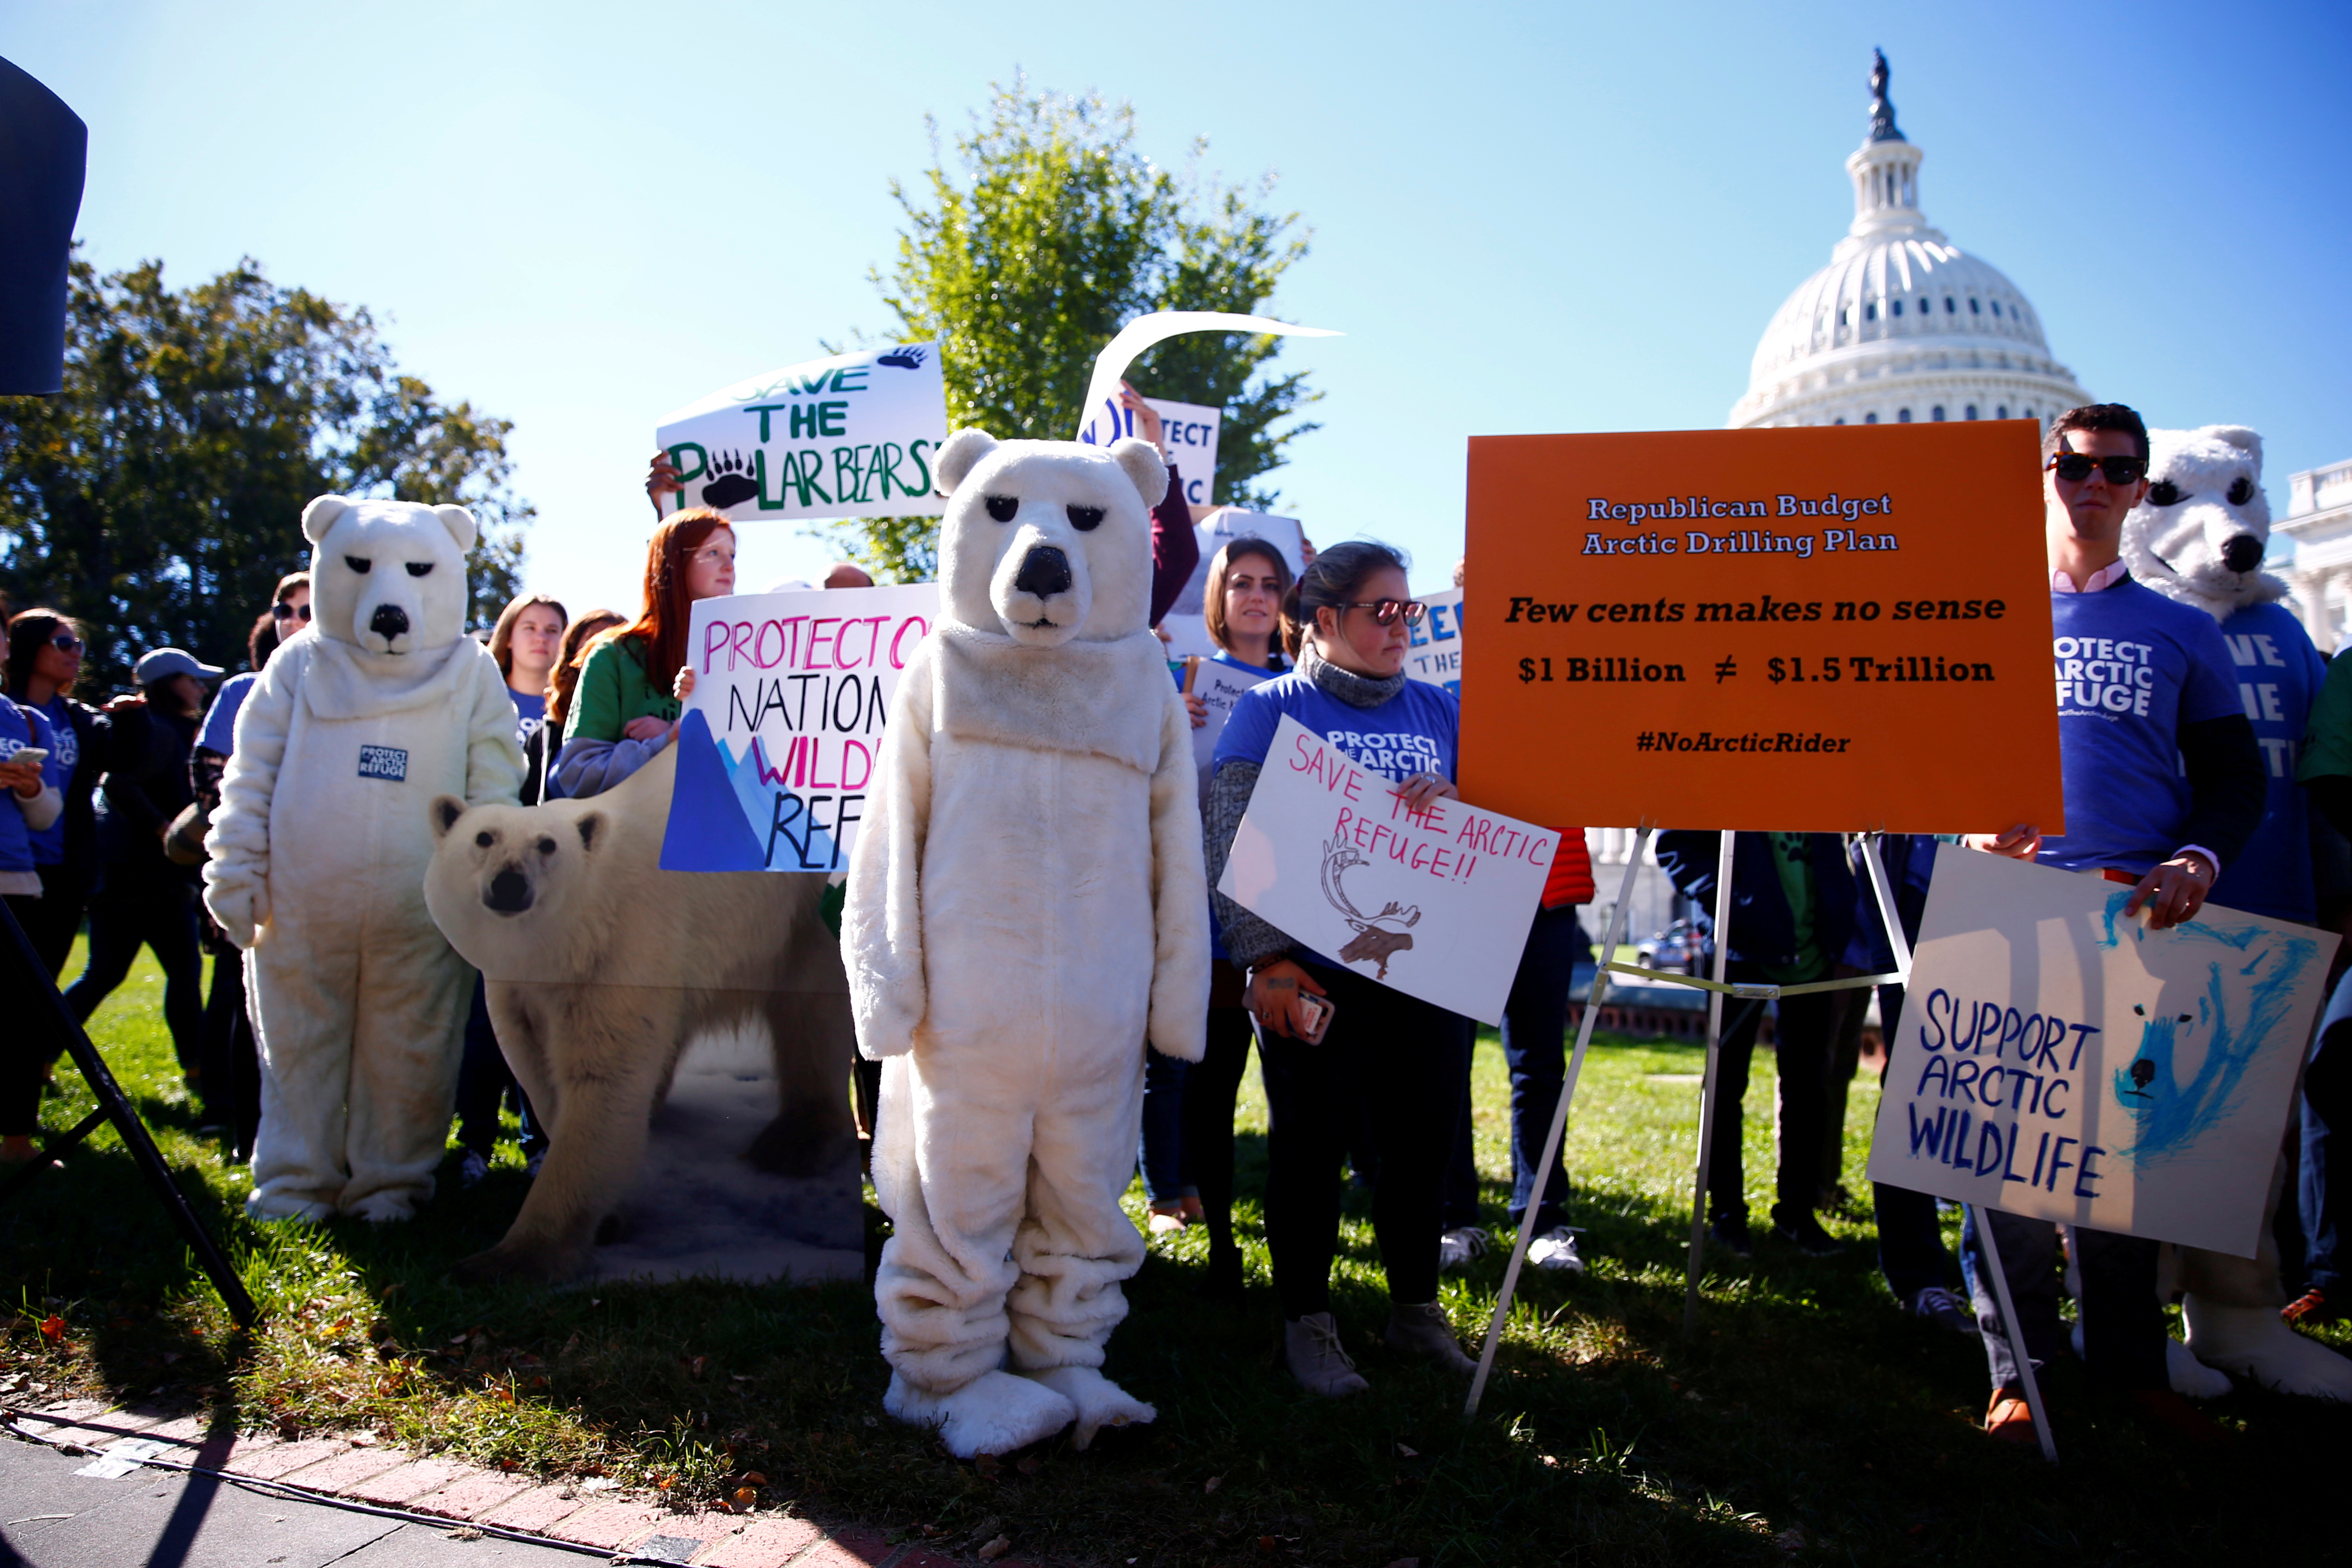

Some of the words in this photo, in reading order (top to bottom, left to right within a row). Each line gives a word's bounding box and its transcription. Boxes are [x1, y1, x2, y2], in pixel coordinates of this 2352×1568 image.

[744, 401, 848, 444] THE
[832, 439, 943, 503] BEARS
[1587, 496, 1767, 525] Republican
[1777, 493, 1891, 521] Budget
[1582, 532, 1677, 555] Arctic
[1685, 531, 1815, 557] Drilling
[1823, 529, 1899, 551] Plan
[1505, 597, 1578, 622] Few
[1587, 598, 1685, 622] cents
[1694, 595, 1822, 621] makes
[1832, 600, 1880, 621] no
[1892, 598, 2006, 620] sense
[704, 616, 890, 674] PROTECT
[889, 616, 933, 669] O
[1413, 651, 1461, 674] THE
[2053, 636, 2152, 665] OTECT
[1519, 657, 1553, 684] $1
[1567, 657, 1685, 682] Billion
[1768, 657, 1841, 684] $1.5
[1850, 657, 1995, 681] Trillion
[2056, 681, 2151, 717] FUGE
[1327, 731, 1437, 757] PROTECT
[1359, 748, 1441, 775] ARCTIC
[1637, 732, 1850, 752] #NoArcticRider
[752, 736, 881, 790] WILD
[1290, 734, 1363, 802] SAVE
[1387, 790, 1448, 834] THE
[1456, 815, 1548, 866] ARCTIC
[765, 792, 865, 869] REF
[1335, 807, 1477, 885] REFUGE!!
[1920, 988, 2101, 1073] SUPPORT
[1917, 1055, 2069, 1119] ARCTIC
[1908, 1101, 2107, 1199] WILDLIFE
